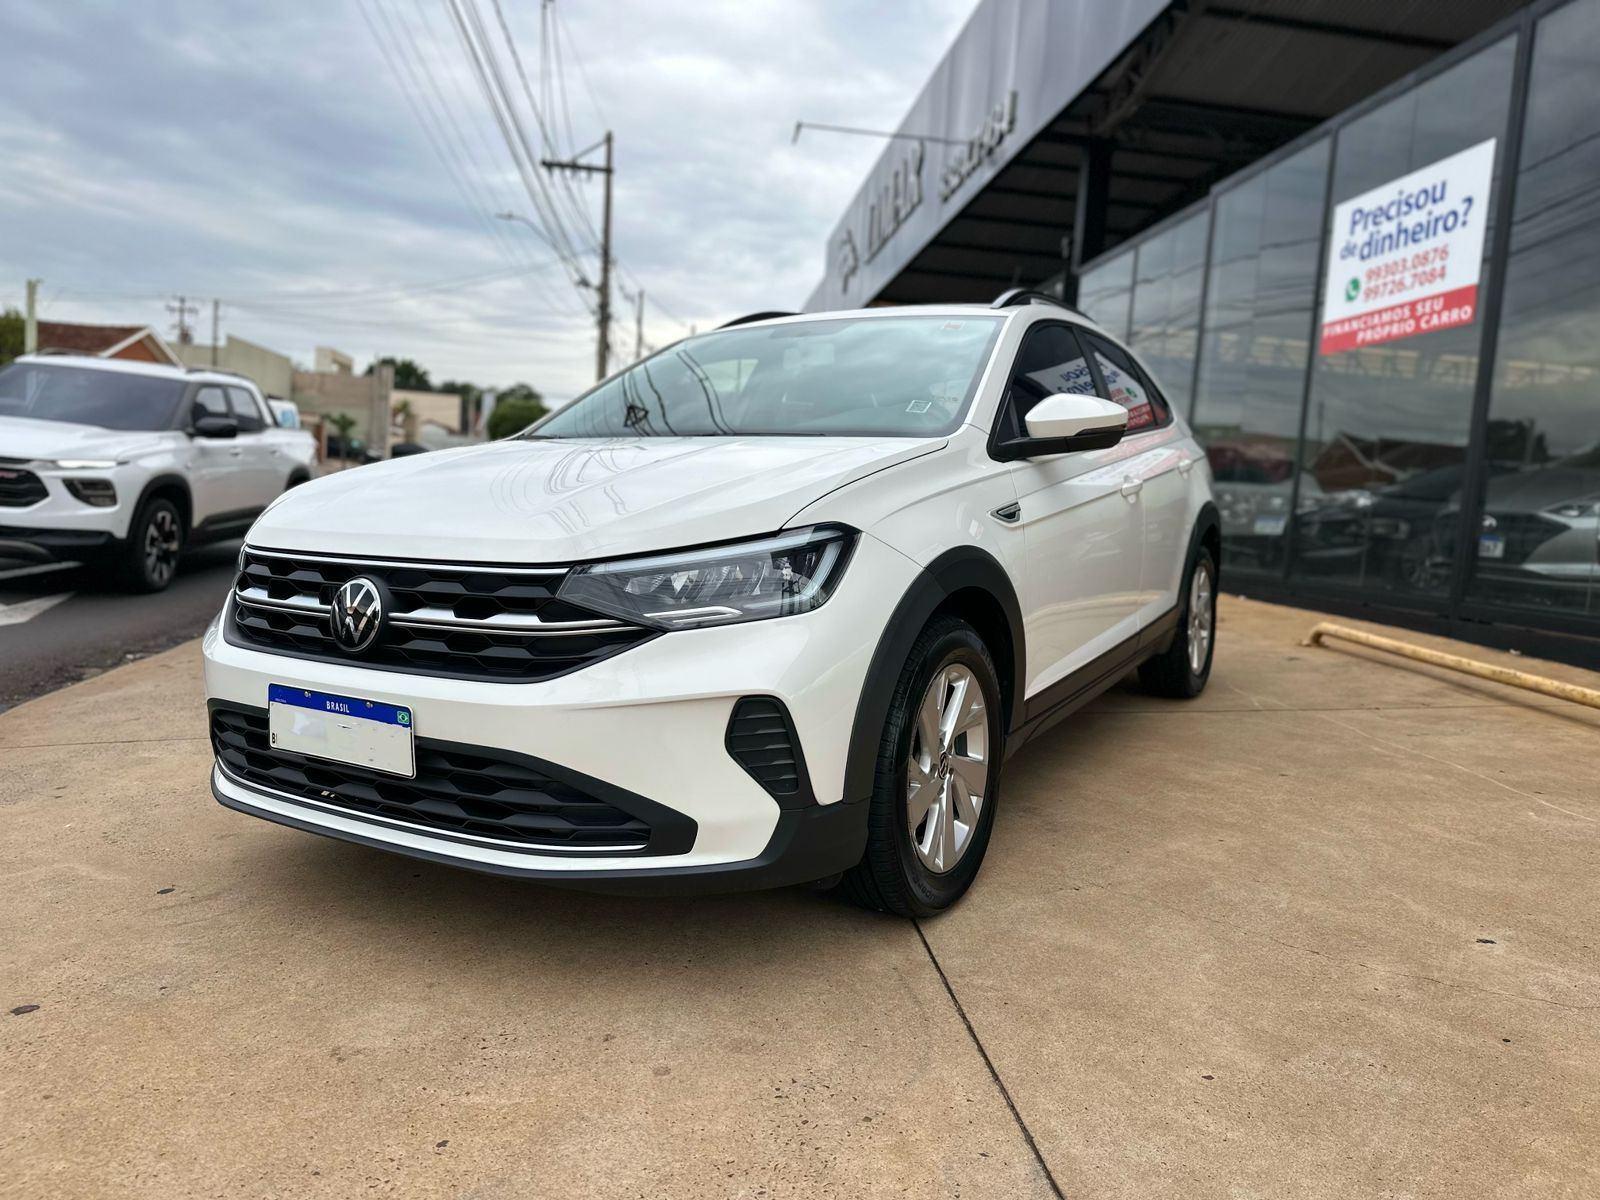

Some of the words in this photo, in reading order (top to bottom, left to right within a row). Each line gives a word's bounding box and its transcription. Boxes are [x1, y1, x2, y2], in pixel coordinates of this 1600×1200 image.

[1339, 241, 1358, 260] de
[1359, 197, 1473, 261] dinheiro?
[1350, 181, 1447, 236] Precisou
[1323, 302, 1412, 338] FINANCIAMOS
[1415, 297, 1444, 314] SEU
[1420, 305, 1472, 329] CARRO
[326, 701, 349, 713] BRASIL
